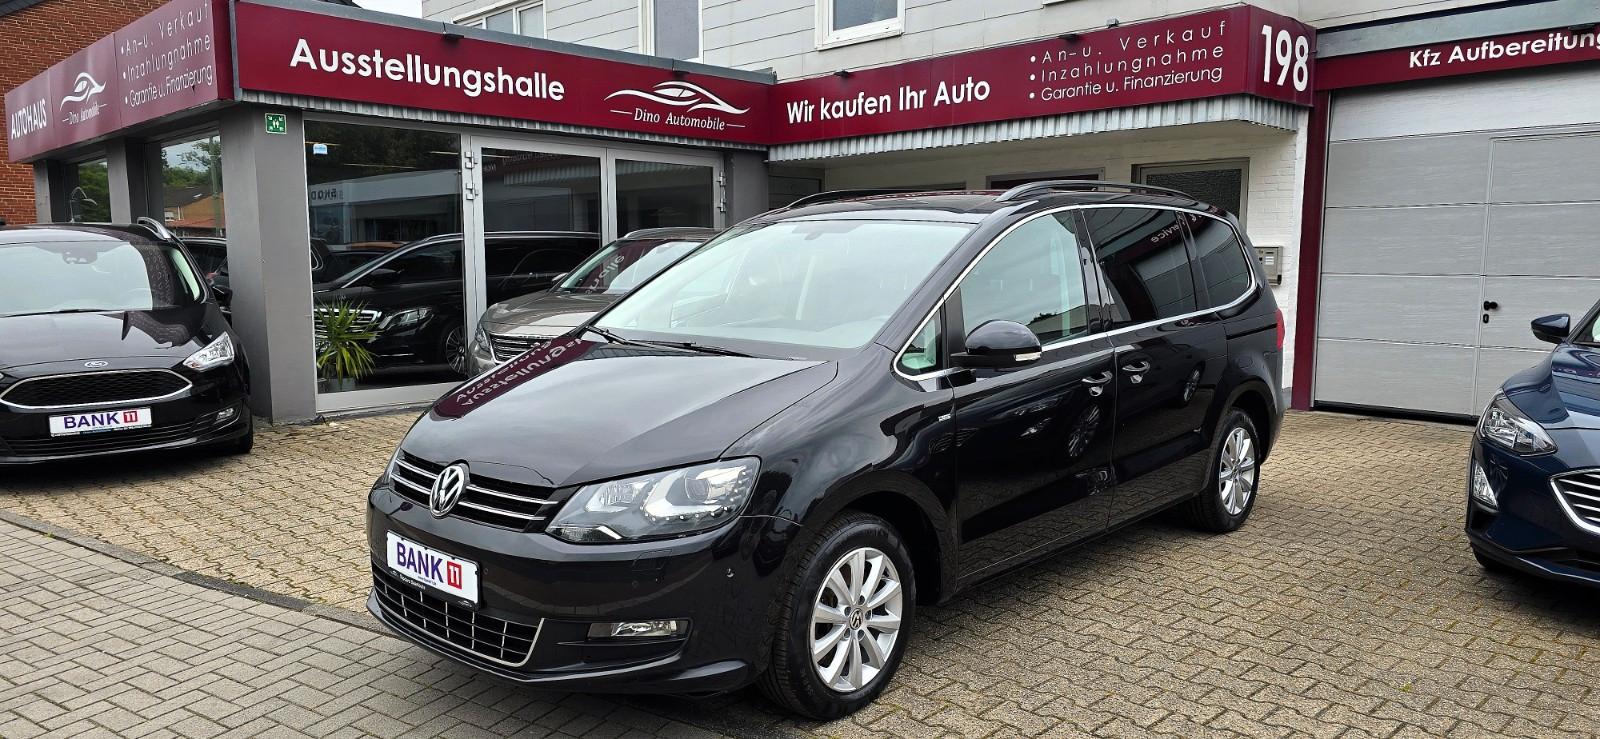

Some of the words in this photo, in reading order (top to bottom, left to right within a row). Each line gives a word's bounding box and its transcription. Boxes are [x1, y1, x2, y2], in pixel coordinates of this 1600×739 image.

[158, 2, 208, 39] Verkauf
[1119, 21, 1227, 51] Verkauf
[127, 34, 211, 83] Inzahlungnahme
[290, 38, 565, 101] Ausstellungshalle
[1041, 45, 1224, 82] Inzahlungnahme
[1262, 25, 1309, 92] 198
[1409, 49, 1441, 68] Kfz
[1447, 33, 1600, 64] Aufbereitun
[129, 81, 157, 107] Garantie
[158, 82, 166, 98] u.
[166, 65, 213, 96] Finanzierung
[786, 99, 815, 124] Wir
[820, 91, 891, 120] kaufen
[899, 85, 927, 111] Ihr
[933, 76, 990, 106] Auto
[1041, 79, 1102, 101] Garantie
[1106, 82, 1119, 93] u.
[1124, 65, 1223, 91] Finanzierung
[11, 98, 47, 139] AUTOHAUS
[634, 108, 660, 123] Dino
[665, 112, 725, 130] Automobile
[64, 412, 120, 429] BANK
[124, 412, 137, 423] 11
[397, 542, 444, 583] BANK
[448, 563, 461, 589] 11
